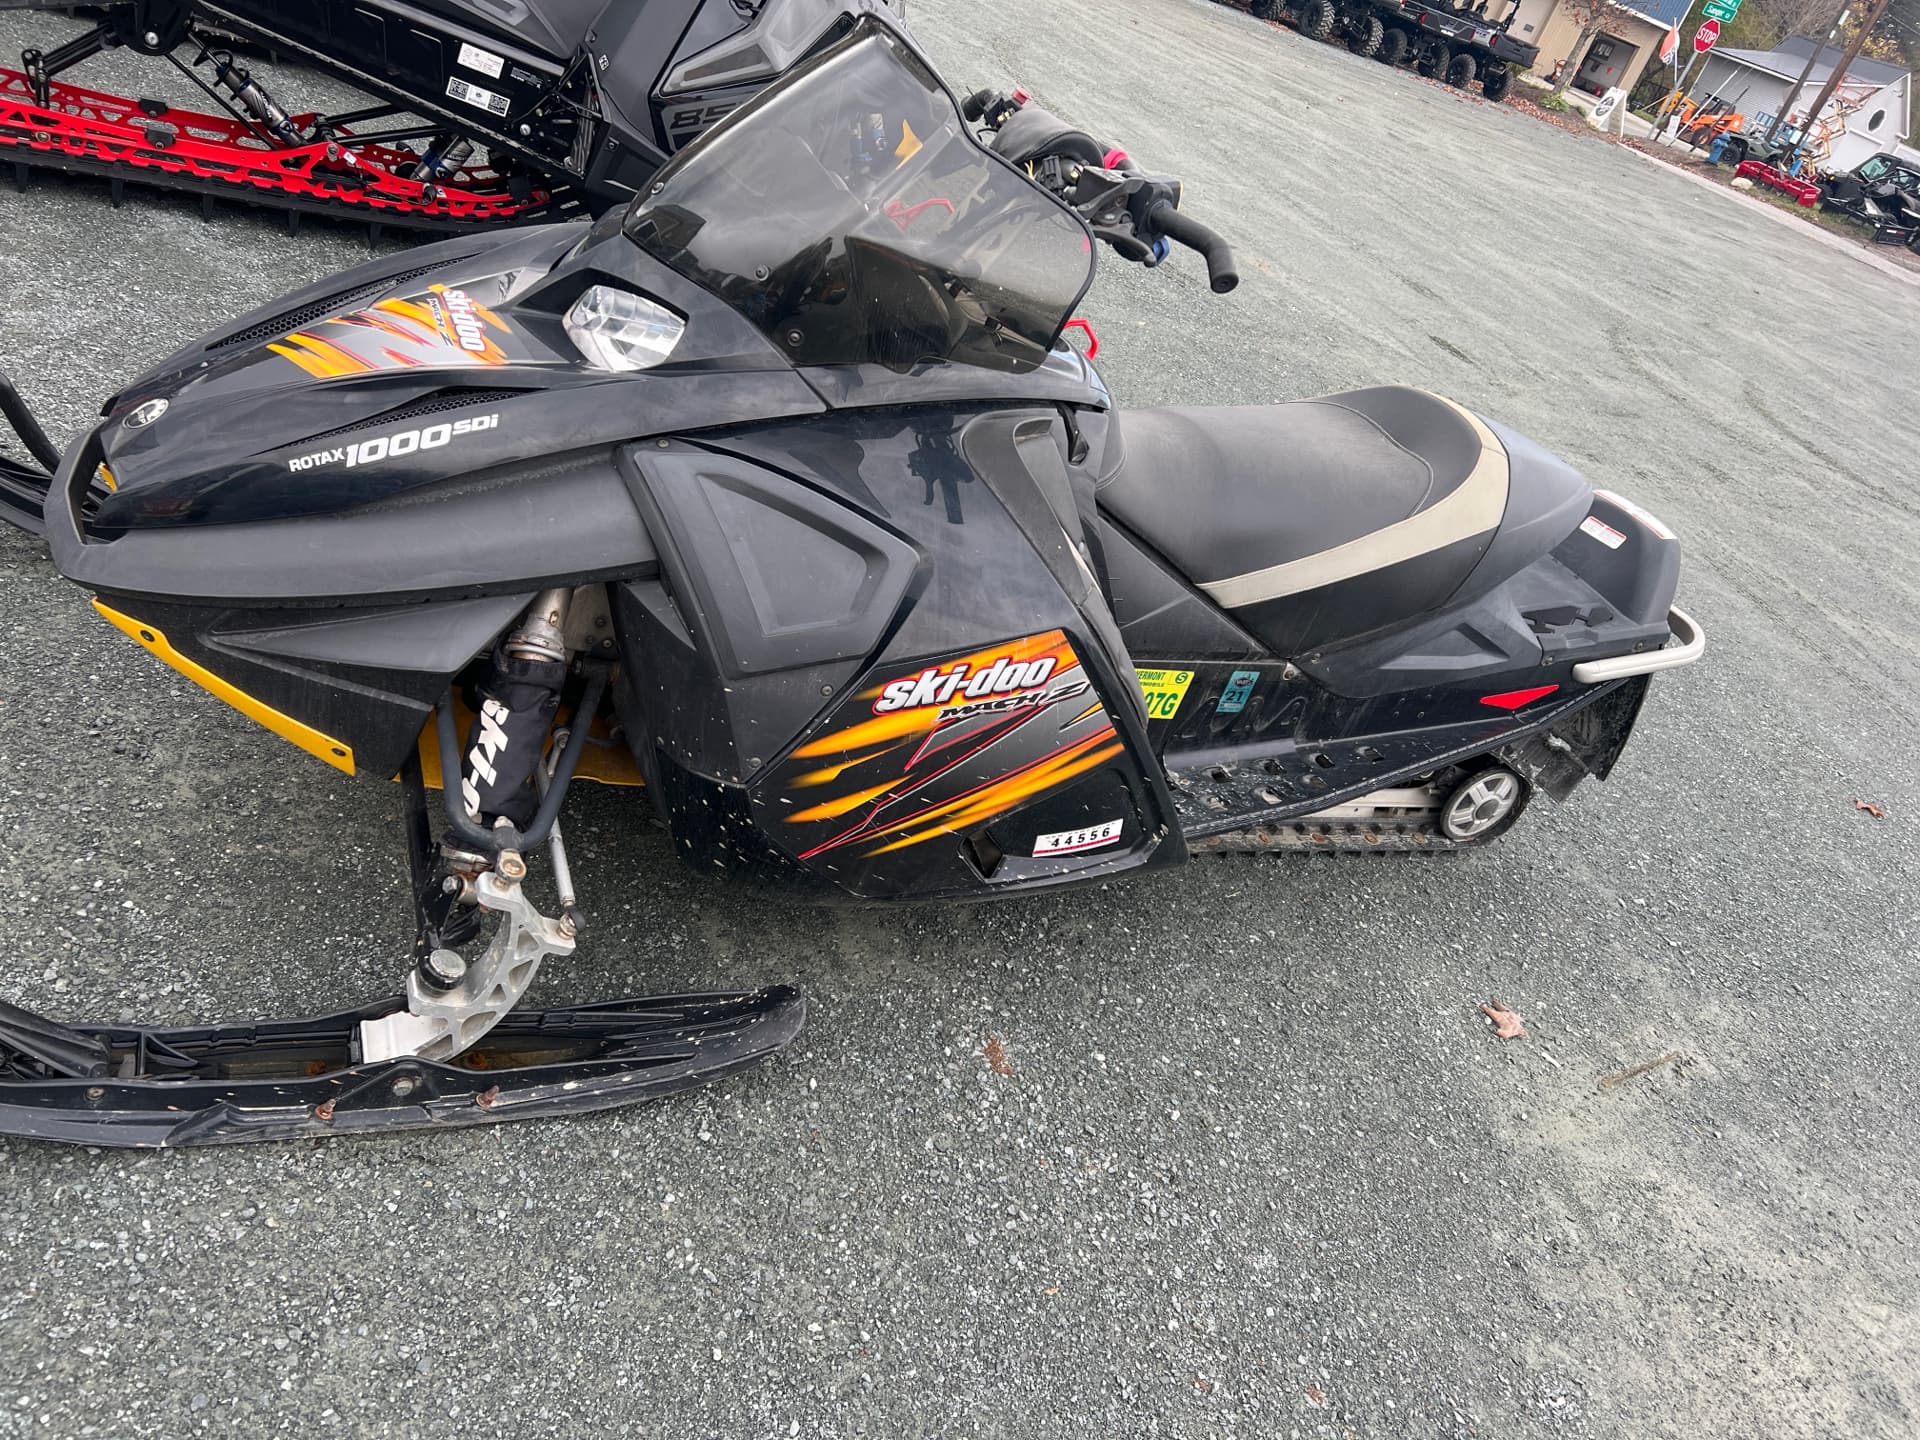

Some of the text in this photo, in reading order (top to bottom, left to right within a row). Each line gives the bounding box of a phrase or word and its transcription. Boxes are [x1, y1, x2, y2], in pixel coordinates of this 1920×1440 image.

[1697, 28, 1717, 44] STOP
[442, 290, 486, 352] ski-doo
[288, 448, 345, 472] ROTAX
[346, 423, 452, 468] 1000
[876, 657, 1057, 712] ski-doo
[936, 680, 1091, 722] MACH Z
[1225, 691, 1244, 702] 21
[1051, 827, 1110, 848] 44556
